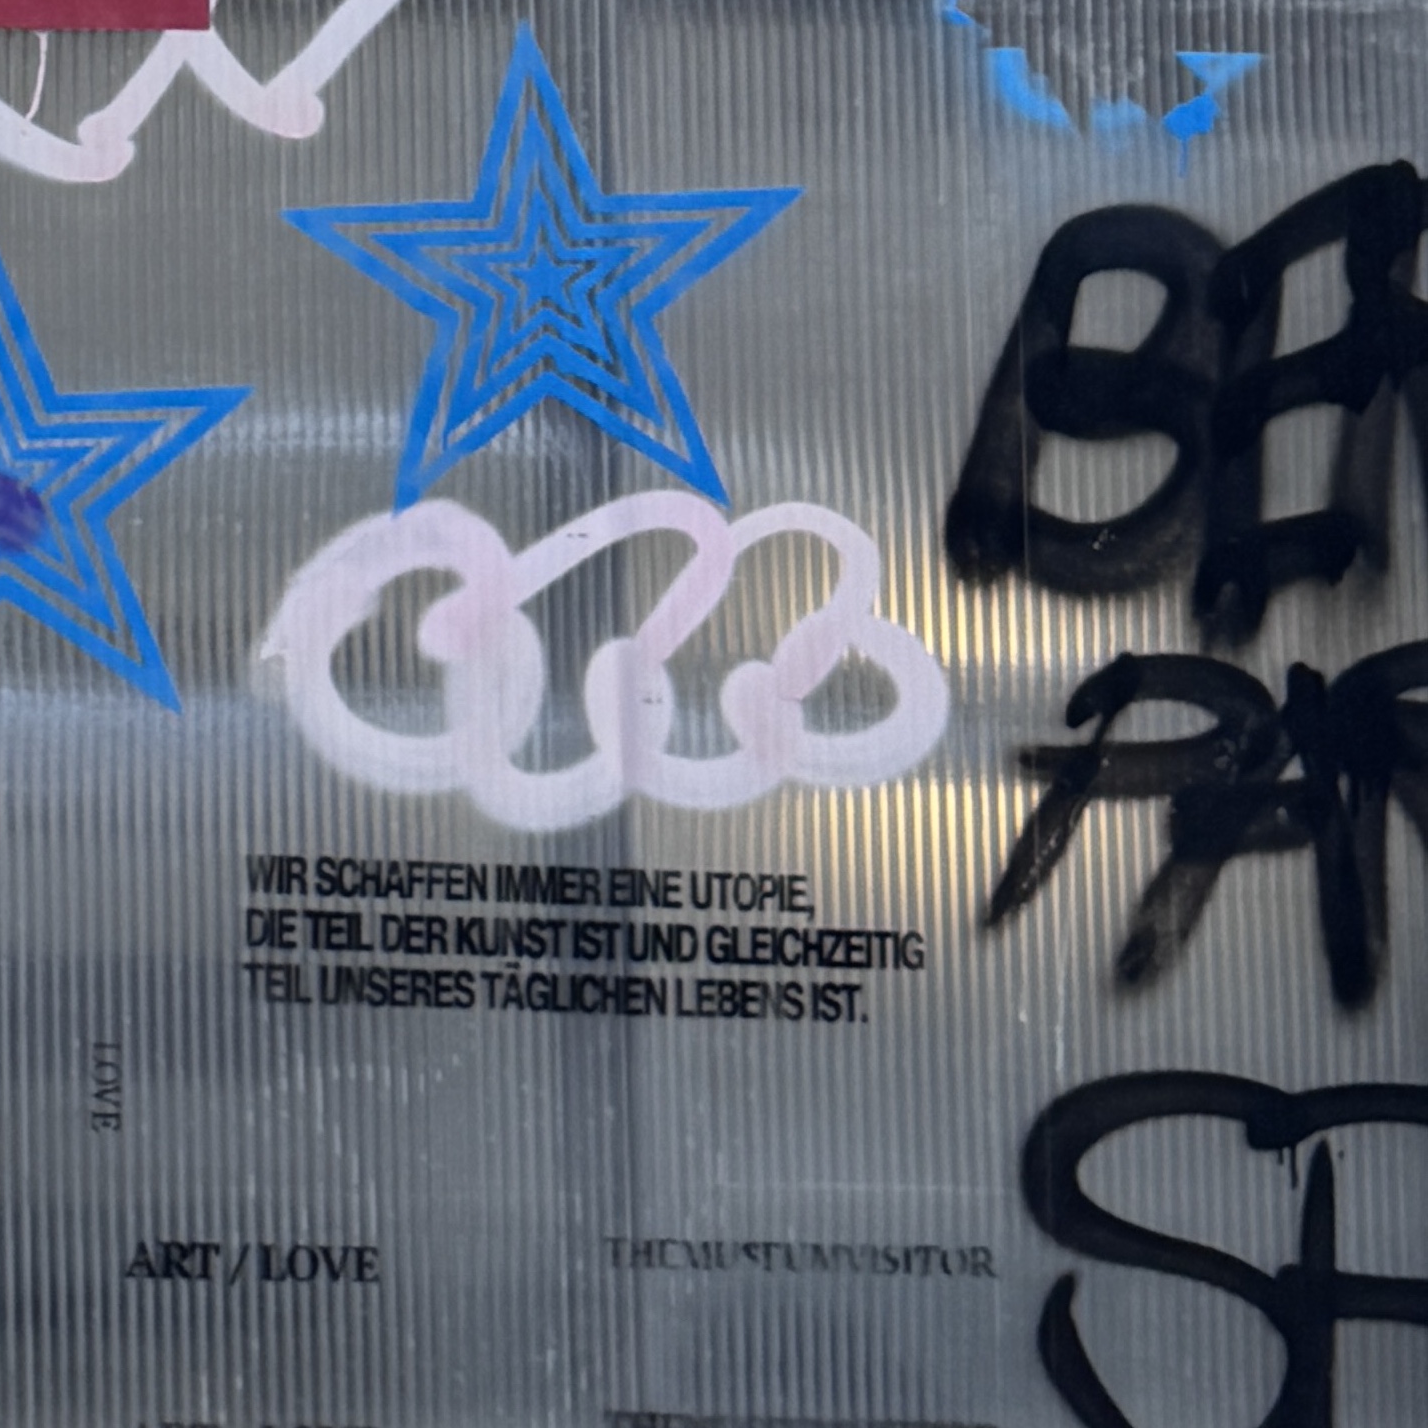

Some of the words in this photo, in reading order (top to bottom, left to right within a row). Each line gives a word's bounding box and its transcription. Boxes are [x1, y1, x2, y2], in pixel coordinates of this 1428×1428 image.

[247, 854, 308, 894] WIR
[315, 857, 487, 901] SCHAFFEN
[496, 864, 600, 905] IMMER
[609, 868, 683, 908] EINE
[691, 871, 814, 921] UTOPIE,
[246, 908, 297, 948] DIE
[303, 910, 373, 951] TEIL
[381, 914, 447, 955] DER
[456, 917, 570, 958] KUNST
[572, 922, 621, 961] IST
[628, 923, 698, 962] UND
[706, 925, 925, 970] GLEICHZEITIG
[244, 963, 311, 1004] TEIL
[319, 965, 475, 1008] UNSERES
[481, 960, 667, 1016] TÄGLICHEN
[676, 978, 804, 1020] LEBENS
[811, 981, 869, 1023] IST.
[125, 1242, 220, 1280] ART
[259, 1243, 379, 1283] LOVE
